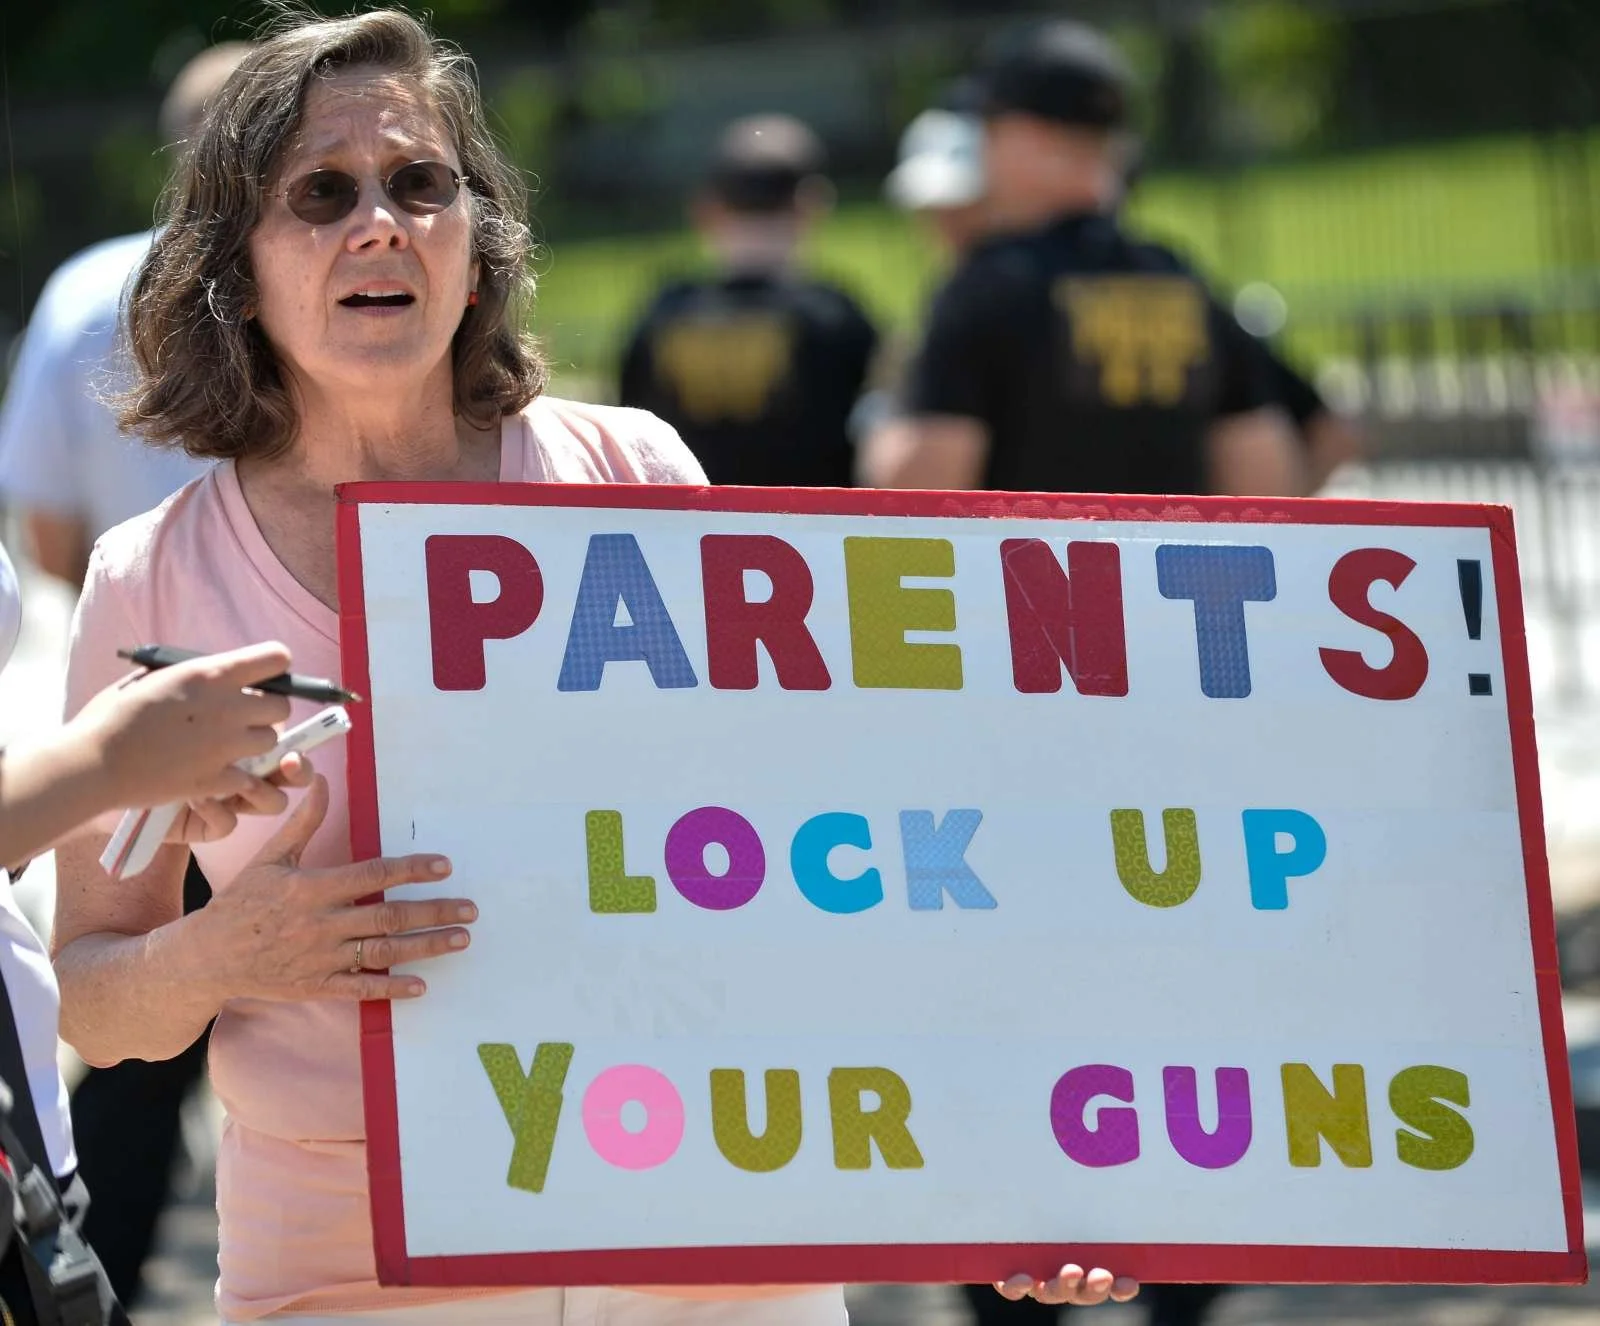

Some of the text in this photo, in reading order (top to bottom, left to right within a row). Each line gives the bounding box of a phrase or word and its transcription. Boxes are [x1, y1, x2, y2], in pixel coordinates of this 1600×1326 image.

[425, 533, 1493, 701] PARENTS!
[586, 805, 1329, 916] LOCK UP
[478, 1043, 1475, 1193] YOUR GUNS
